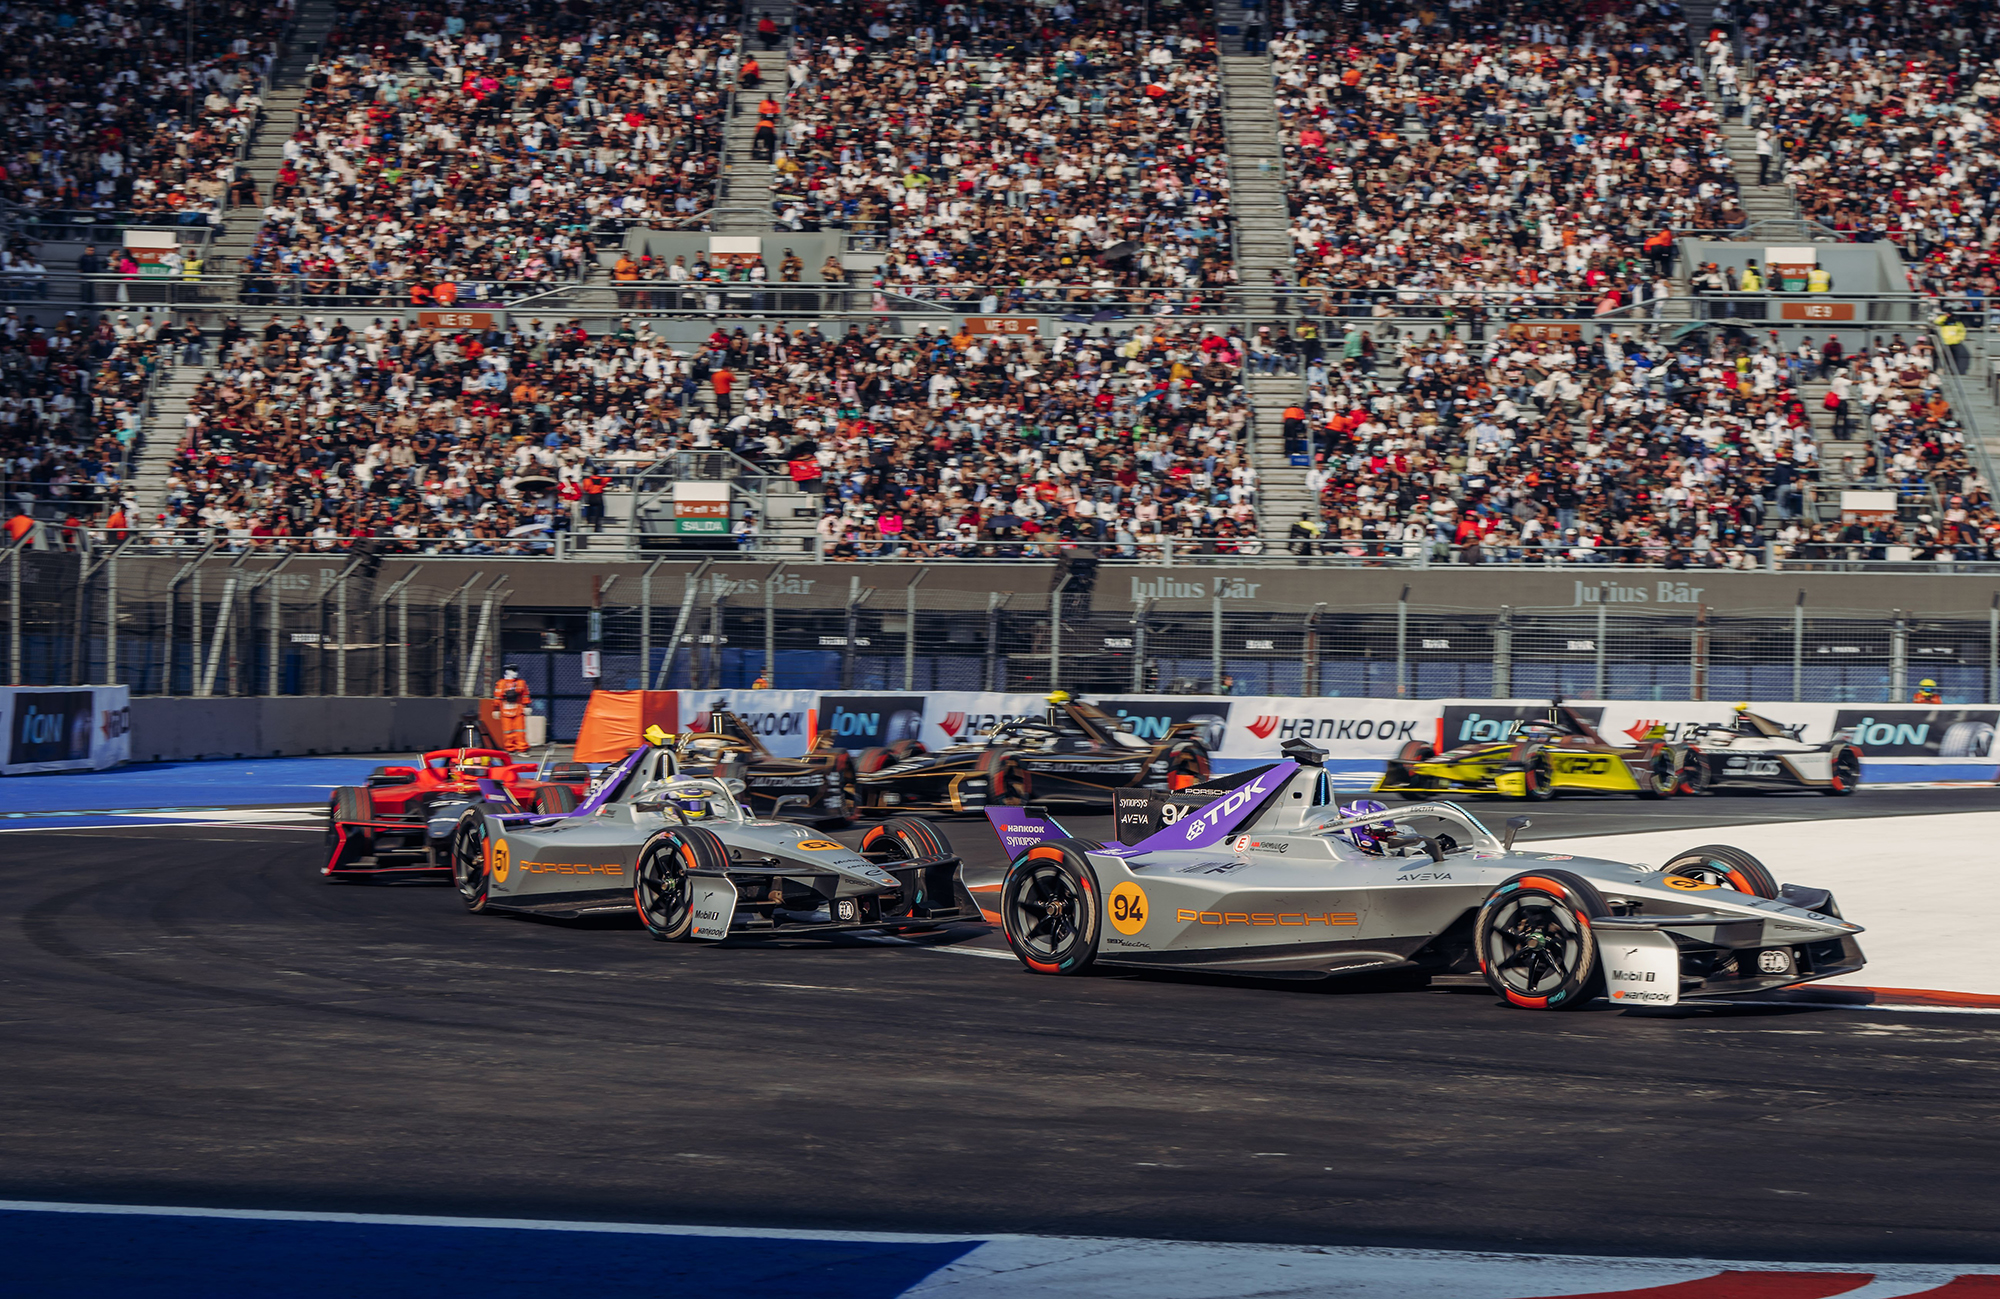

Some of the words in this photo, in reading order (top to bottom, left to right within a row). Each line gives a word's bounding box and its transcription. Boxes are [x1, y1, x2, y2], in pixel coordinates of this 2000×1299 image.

[681, 521, 724, 532] SALIDA
[1131, 576, 1205, 601] Julius
[1573, 580, 1649, 607] Julius
[1656, 581, 1705, 603] Bär
[831, 705, 880, 737] iON
[1852, 717, 1930, 746] iON
[1203, 774, 1267, 826] TDK
[1121, 814, 1149, 825] AVEVA
[494, 848, 508, 872] 51
[519, 859, 624, 876] PORSCHE
[1397, 872, 1452, 882] AVEVA
[695, 909, 711, 920] Mobil
[1113, 894, 1144, 922] 94
[1176, 907, 1359, 927] PORSCHE
[1761, 953, 1789, 968] FIA
[1612, 969, 1643, 983] Mobil
